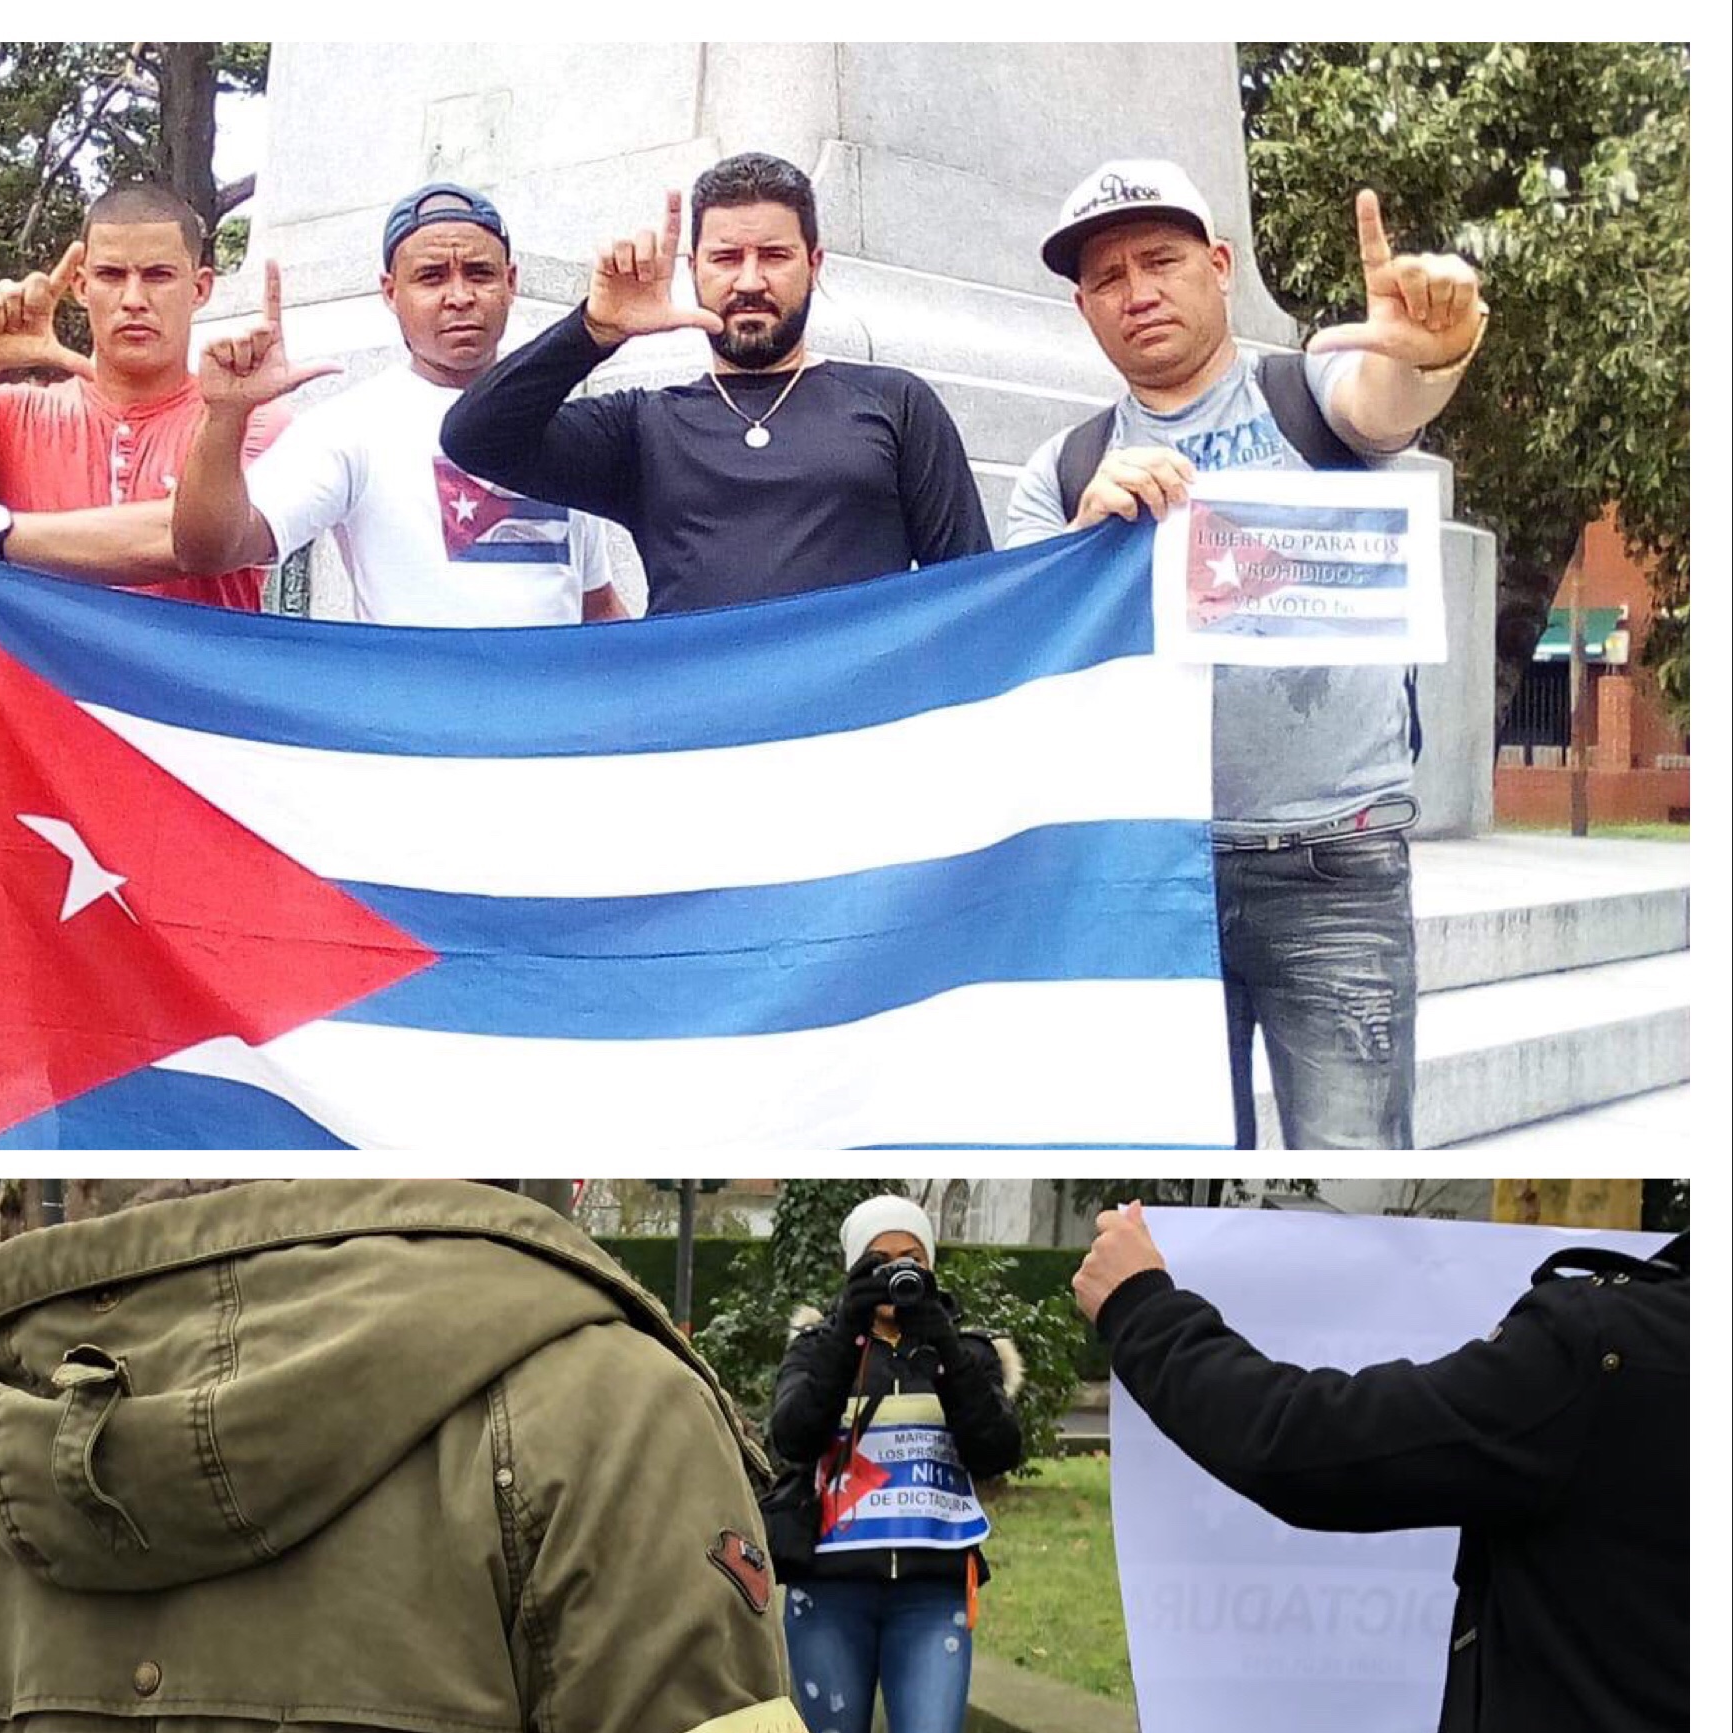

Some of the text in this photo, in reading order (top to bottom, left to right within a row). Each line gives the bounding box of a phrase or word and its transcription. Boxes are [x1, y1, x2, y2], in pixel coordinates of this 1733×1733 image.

[1198, 530, 1399, 554] LIBERTAD PARA LOS
[1269, 598, 1327, 614] VOTO
[878, 1448, 905, 1460] LOS
[912, 1462, 933, 1482] NI
[870, 1492, 892, 1506] DE
